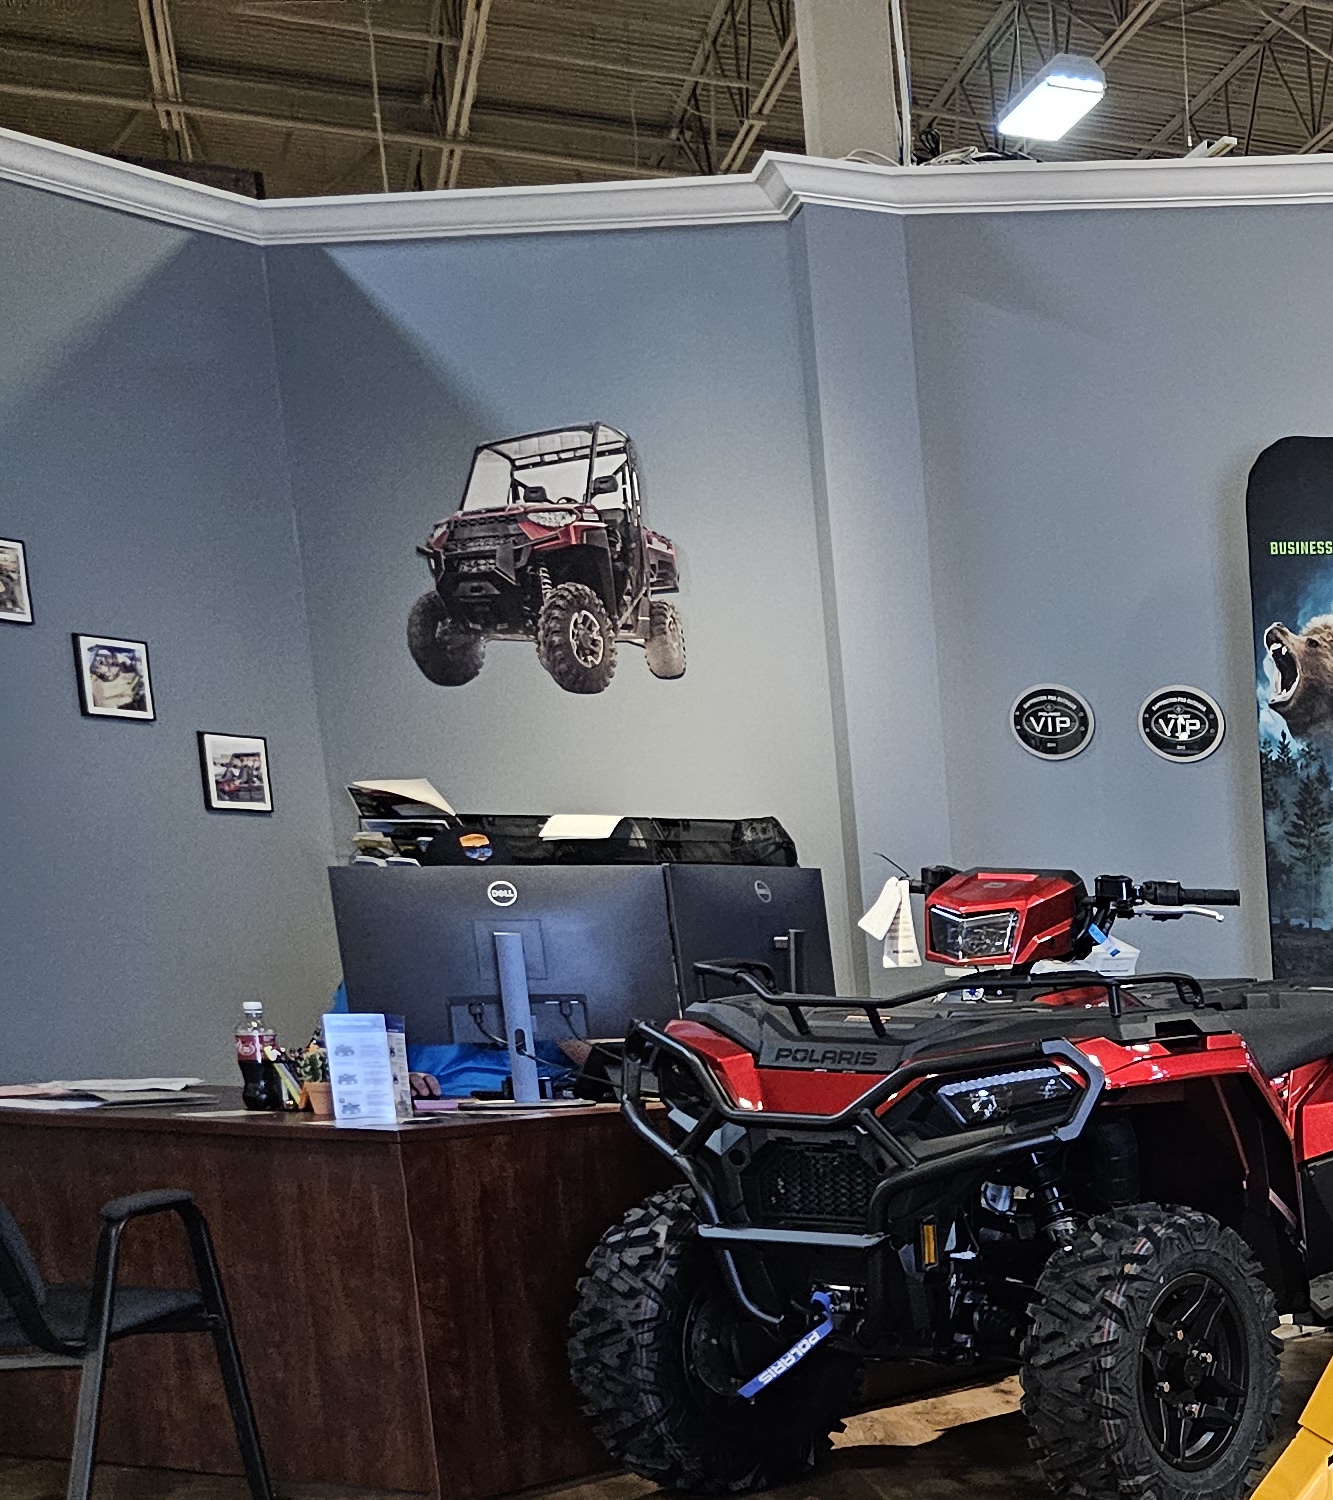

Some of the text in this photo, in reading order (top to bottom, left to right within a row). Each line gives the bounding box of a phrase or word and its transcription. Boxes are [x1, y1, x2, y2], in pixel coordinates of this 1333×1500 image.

[1270, 541, 1333, 556] BUSINESS
[1029, 716, 1071, 733] VIP
[1158, 718, 1201, 737] VIP
[774, 1047, 878, 1067] POLARIS
[758, 1331, 821, 1385] POLARIS
